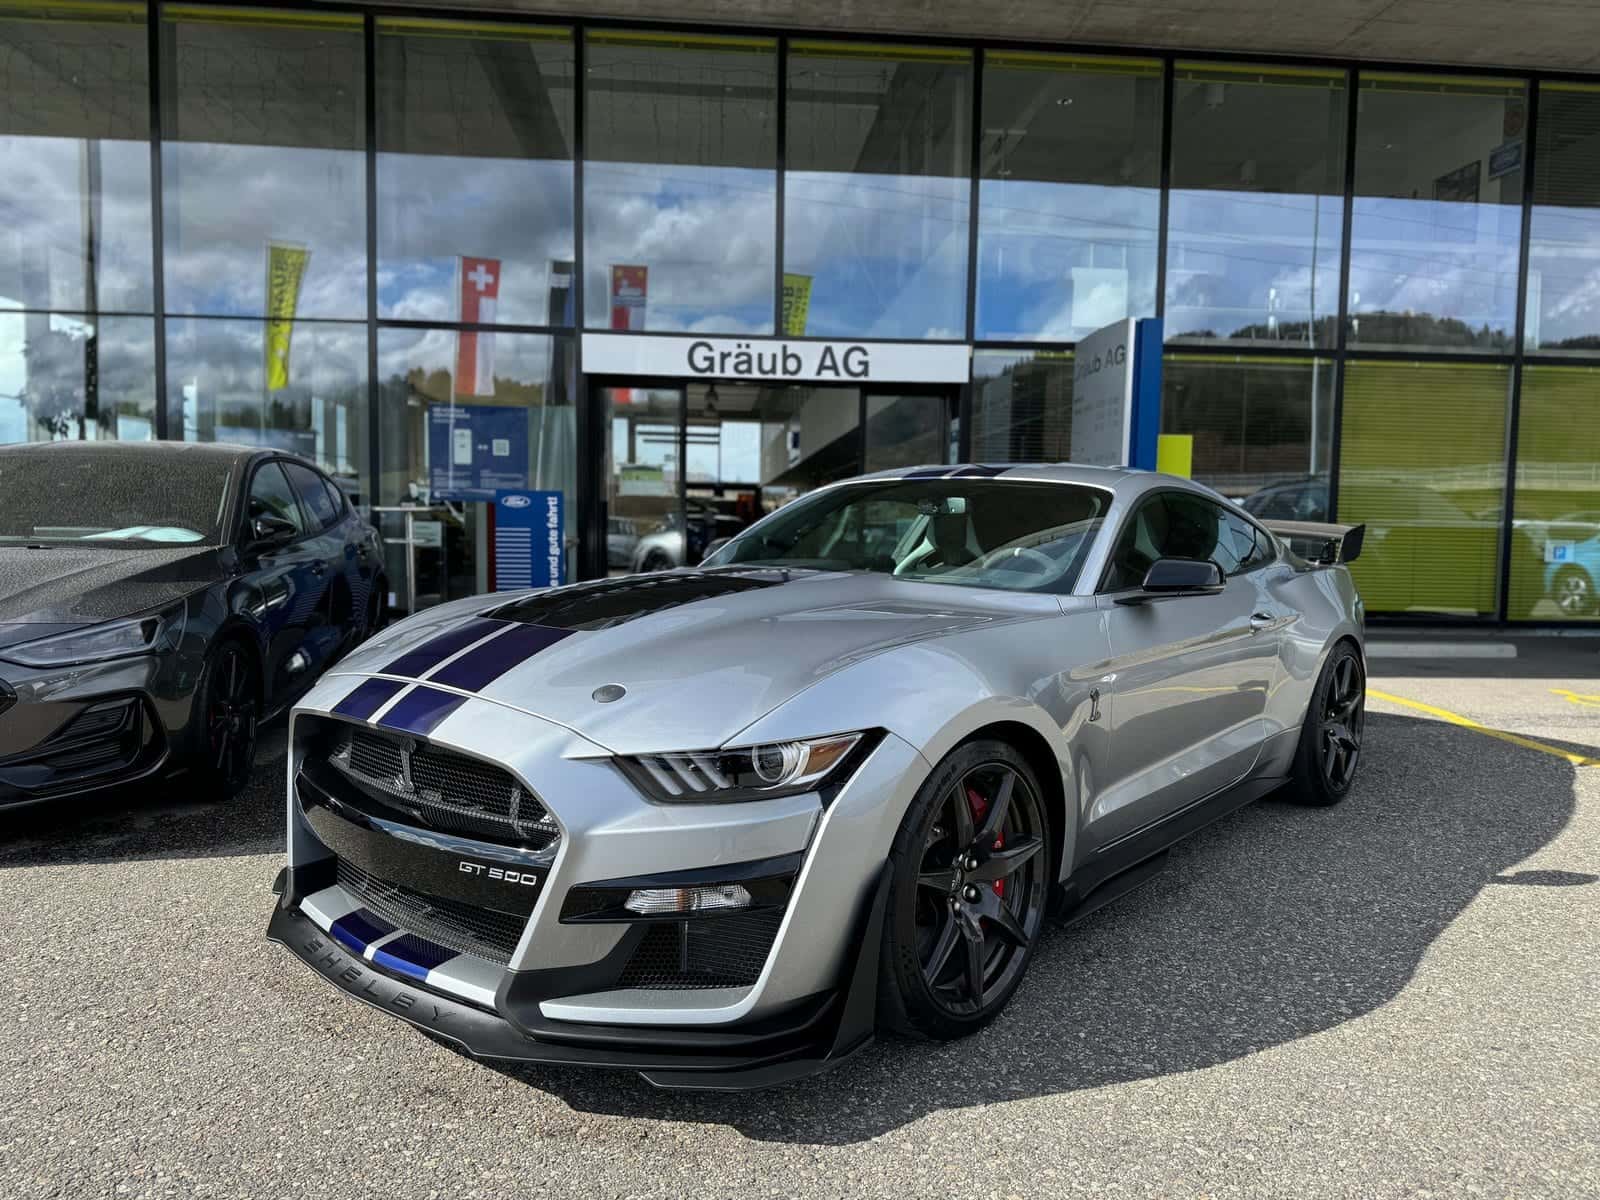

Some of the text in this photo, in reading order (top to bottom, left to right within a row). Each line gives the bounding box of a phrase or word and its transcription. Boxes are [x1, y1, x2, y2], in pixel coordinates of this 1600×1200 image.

[687, 341, 870, 377] Gräub AG
[1104, 344, 1125, 368] AG
[548, 529, 560, 555] gute
[547, 556, 559, 578] und
[458, 861, 537, 886] GT 500
[303, 938, 456, 1021] SHELBY
